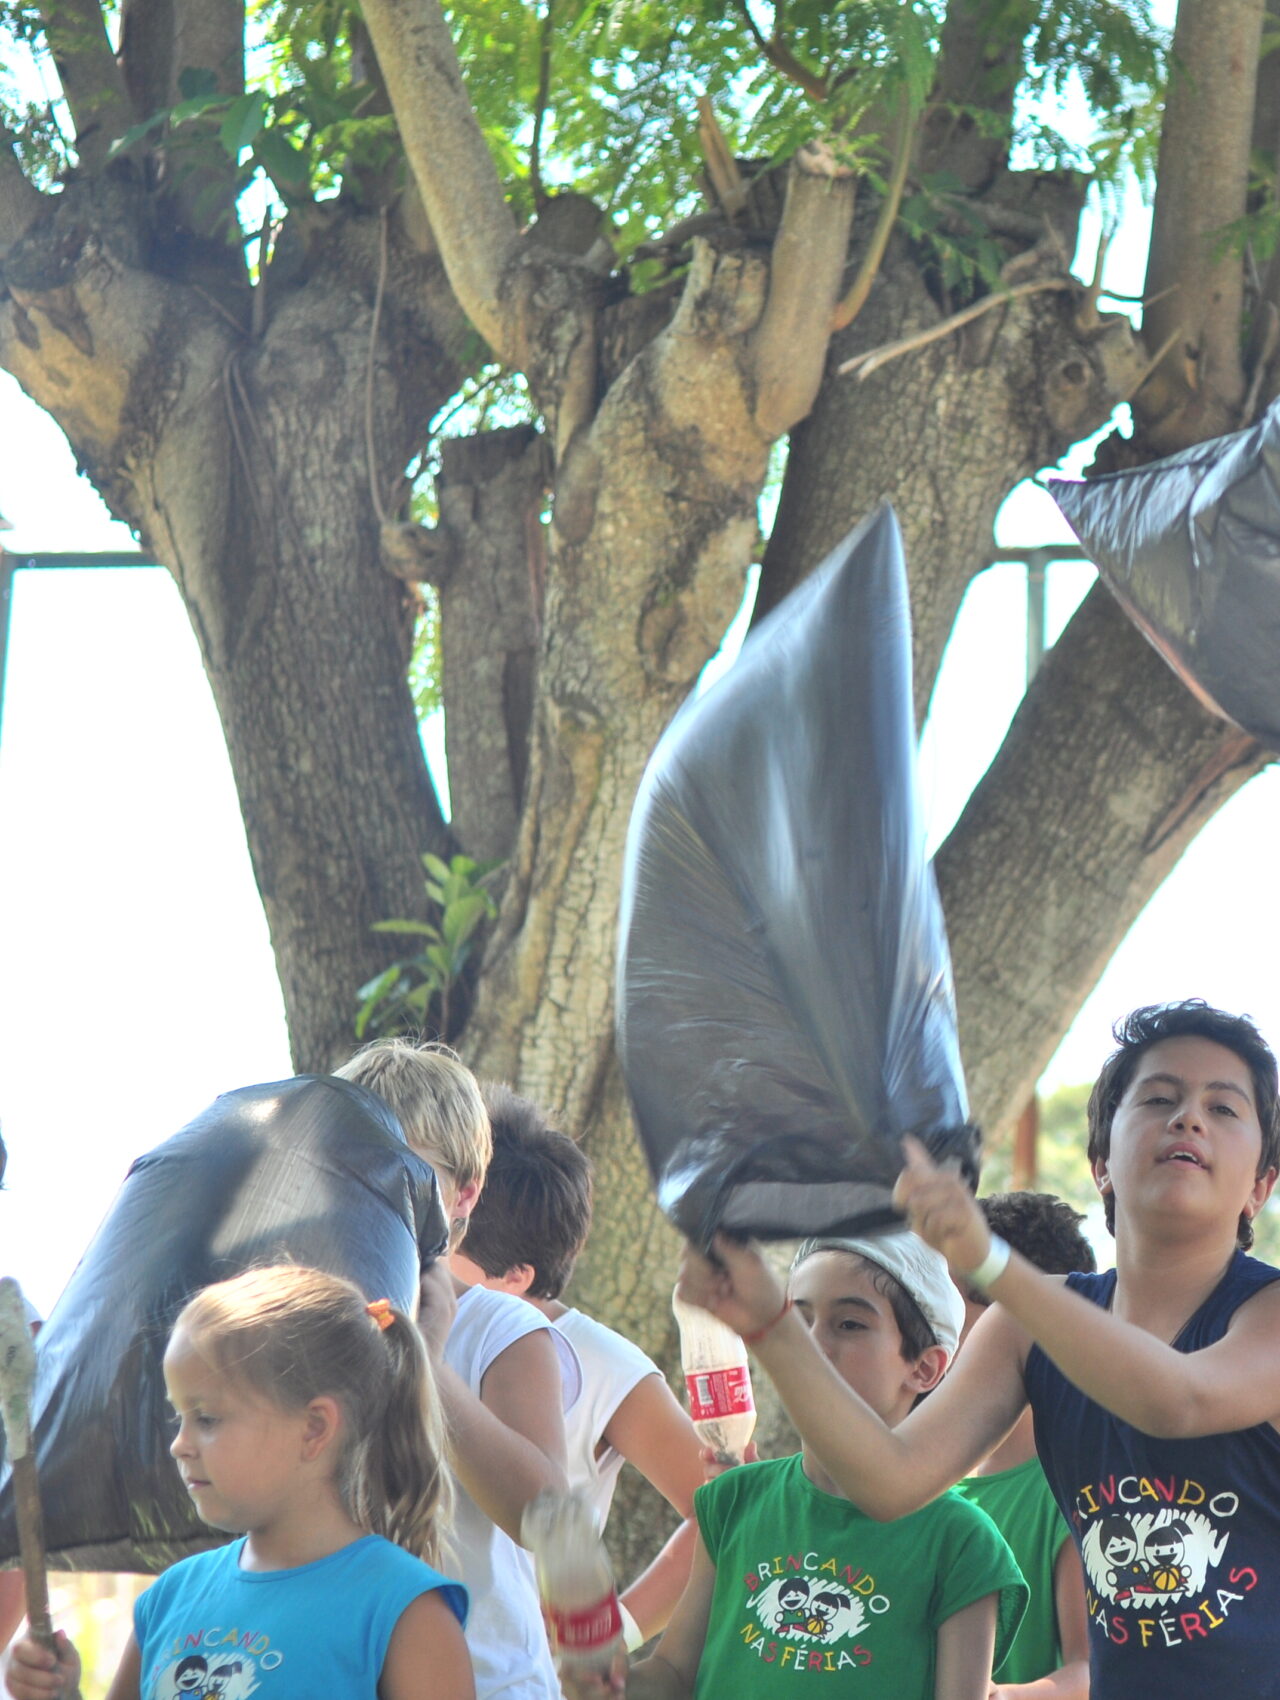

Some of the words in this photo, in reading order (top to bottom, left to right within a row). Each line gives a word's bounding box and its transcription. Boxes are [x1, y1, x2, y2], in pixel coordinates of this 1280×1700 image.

[744, 1552, 890, 1614] BRINCANDO
[1087, 1588, 1129, 1644] NAS
[1138, 1566, 1258, 1647] FÉRIAS
[740, 1623, 778, 1663] NAS
[781, 1643, 873, 1672] FÉRIAS
